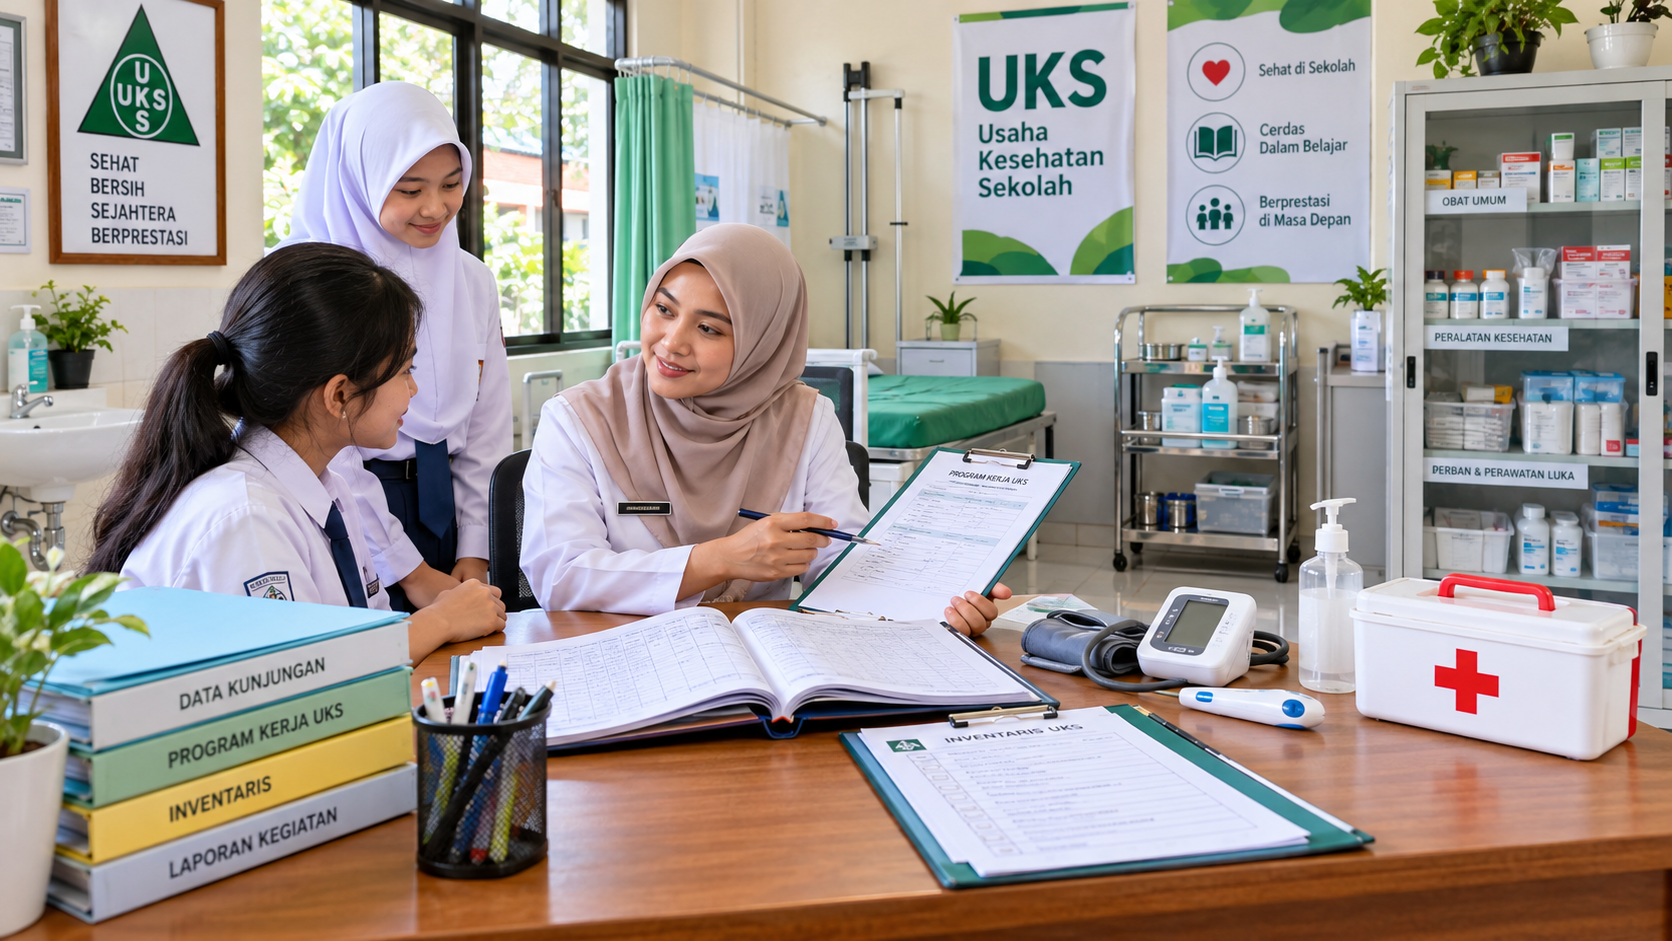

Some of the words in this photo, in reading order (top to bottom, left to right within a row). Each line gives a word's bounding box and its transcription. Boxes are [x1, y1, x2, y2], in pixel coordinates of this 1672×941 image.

[1259, 63, 1292, 77] Sehat
[1294, 62, 1305, 75] di
[1308, 59, 1356, 75] Sekolah
[978, 49, 1107, 112] UKS
[117, 83, 166, 110] UKS
[978, 121, 1048, 144] Usaha
[1259, 122, 1305, 137] Cerdas
[1260, 140, 1299, 154] Dalam
[1303, 138, 1348, 155] Belajar
[90, 152, 139, 172] SEHAT
[978, 146, 1104, 171] Kesehatan
[91, 178, 145, 197] BERSIH
[978, 173, 1072, 198] Sekolah
[1259, 194, 1330, 211] Berprestasi
[1442, 196, 1469, 206] OBAT
[1472, 195, 1506, 205] UMUM
[91, 202, 176, 222] SEJAHTERA
[1259, 214, 1271, 227] di
[1274, 213, 1307, 227] Masa
[1311, 213, 1351, 229] Depan
[92, 227, 188, 246] BERPRESTASI
[1434, 332, 1491, 342] PERALATAN
[1494, 333, 1552, 343] KESEHATAN
[948, 470, 986, 480] PROGRAM
[986, 475, 1010, 483] KERJA
[1011, 477, 1029, 485] UKS
[1474, 467, 1481, 476] &
[1484, 468, 1545, 479] PERAWATAN
[1548, 470, 1575, 480] LUKA
[178, 685, 223, 711] DATA
[228, 657, 326, 695] KUNJUNGAN
[168, 729, 254, 768] PROGRAM
[259, 713, 310, 742] KERJA
[313, 703, 344, 724] UKS
[945, 728, 1044, 743] INVENTARIS
[168, 776, 272, 823] INVENTARIS
[169, 836, 253, 879] LAPORAN
[258, 806, 338, 845] KEGIATAN
